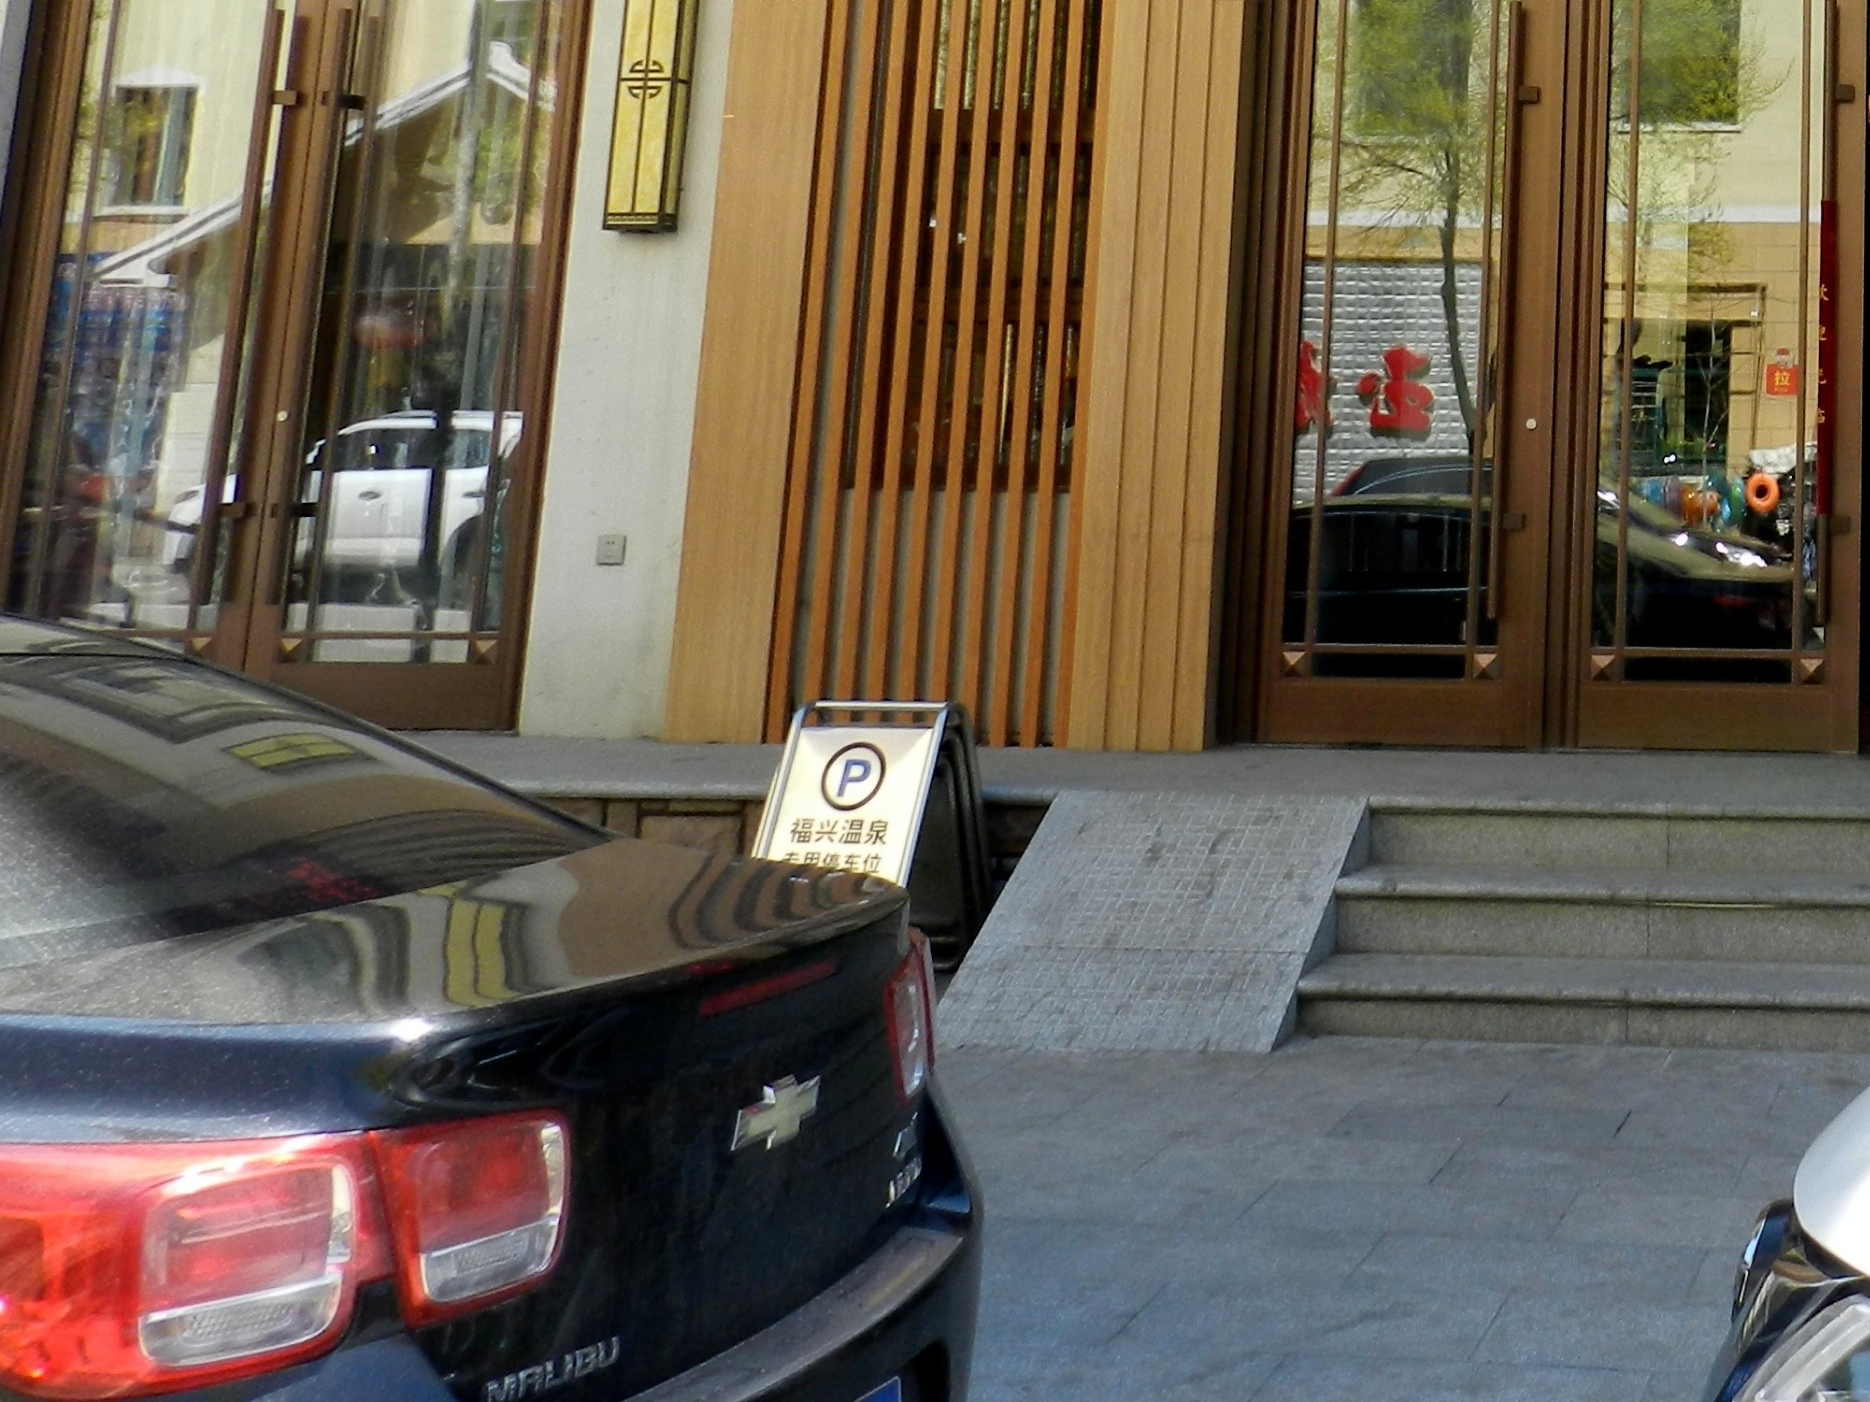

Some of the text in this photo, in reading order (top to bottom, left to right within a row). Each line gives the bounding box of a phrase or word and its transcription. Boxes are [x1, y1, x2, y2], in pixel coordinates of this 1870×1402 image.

[1774, 370, 1791, 387] 拉
[836, 759, 872, 798] P
[790, 818, 889, 846] 福兴温泉
